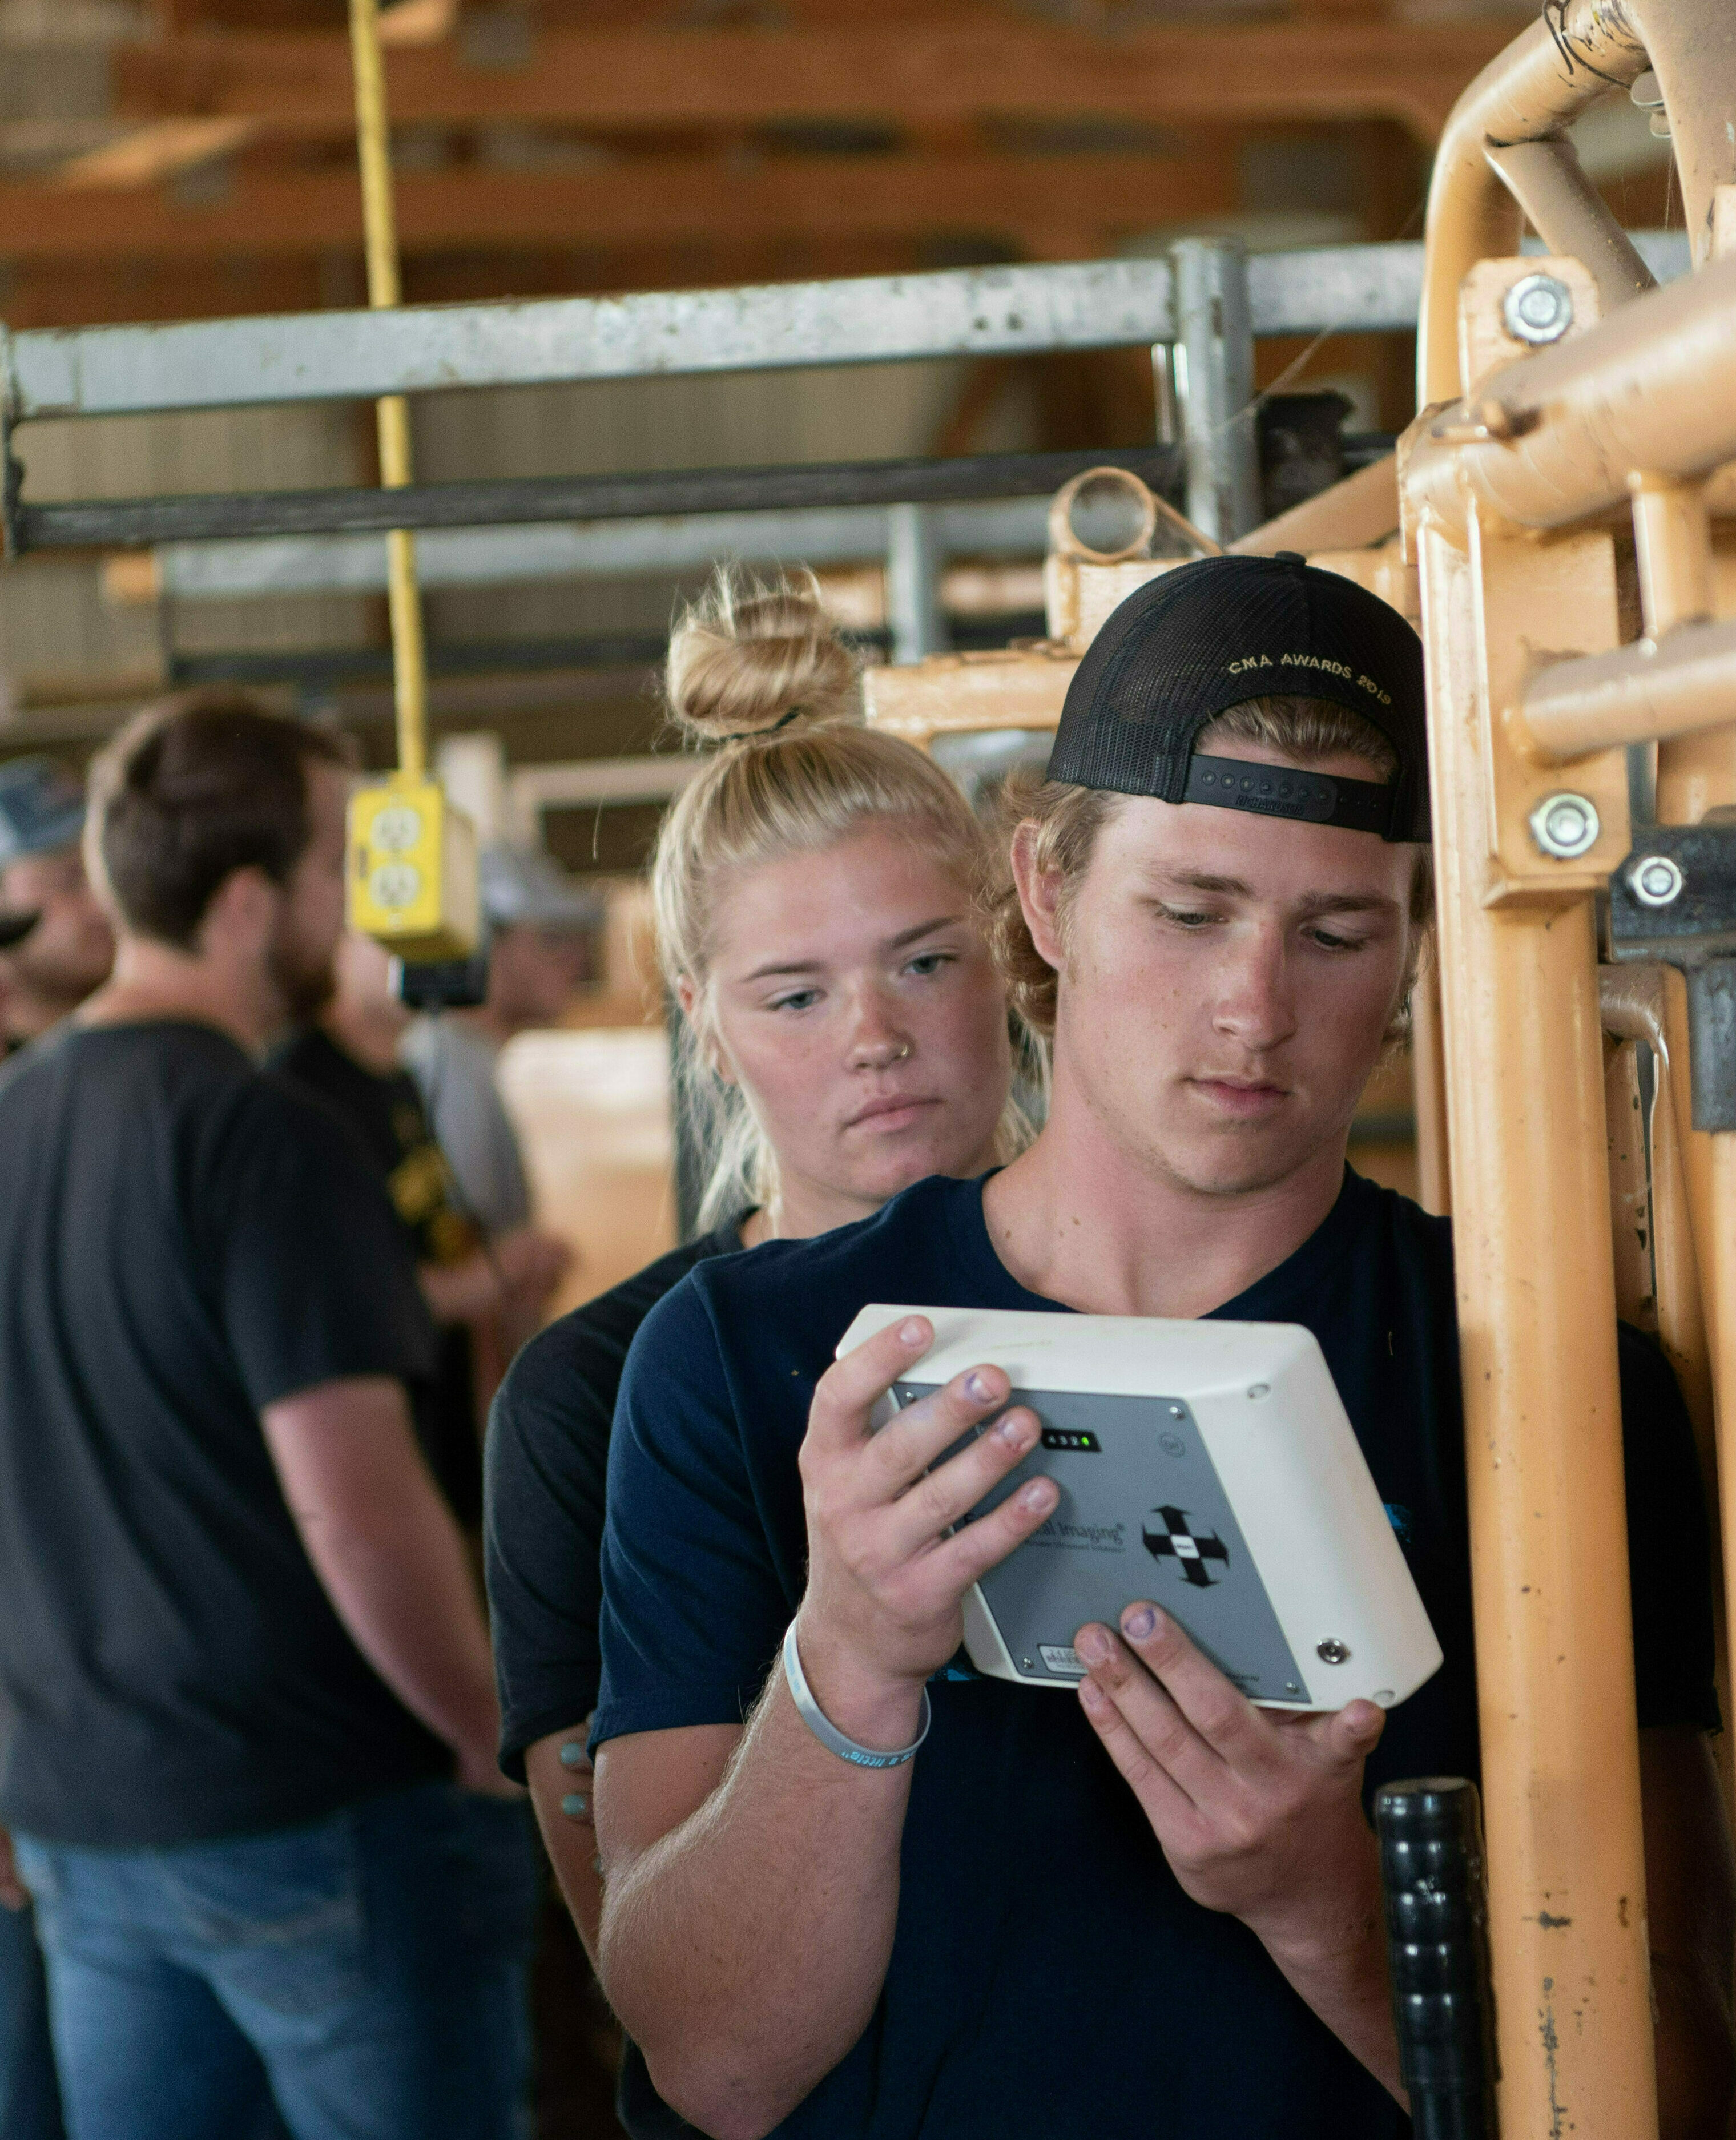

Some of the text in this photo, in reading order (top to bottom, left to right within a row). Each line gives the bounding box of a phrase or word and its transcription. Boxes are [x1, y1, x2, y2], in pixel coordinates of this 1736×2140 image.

[1229, 653, 1392, 705] CMA AWARDS 2019
